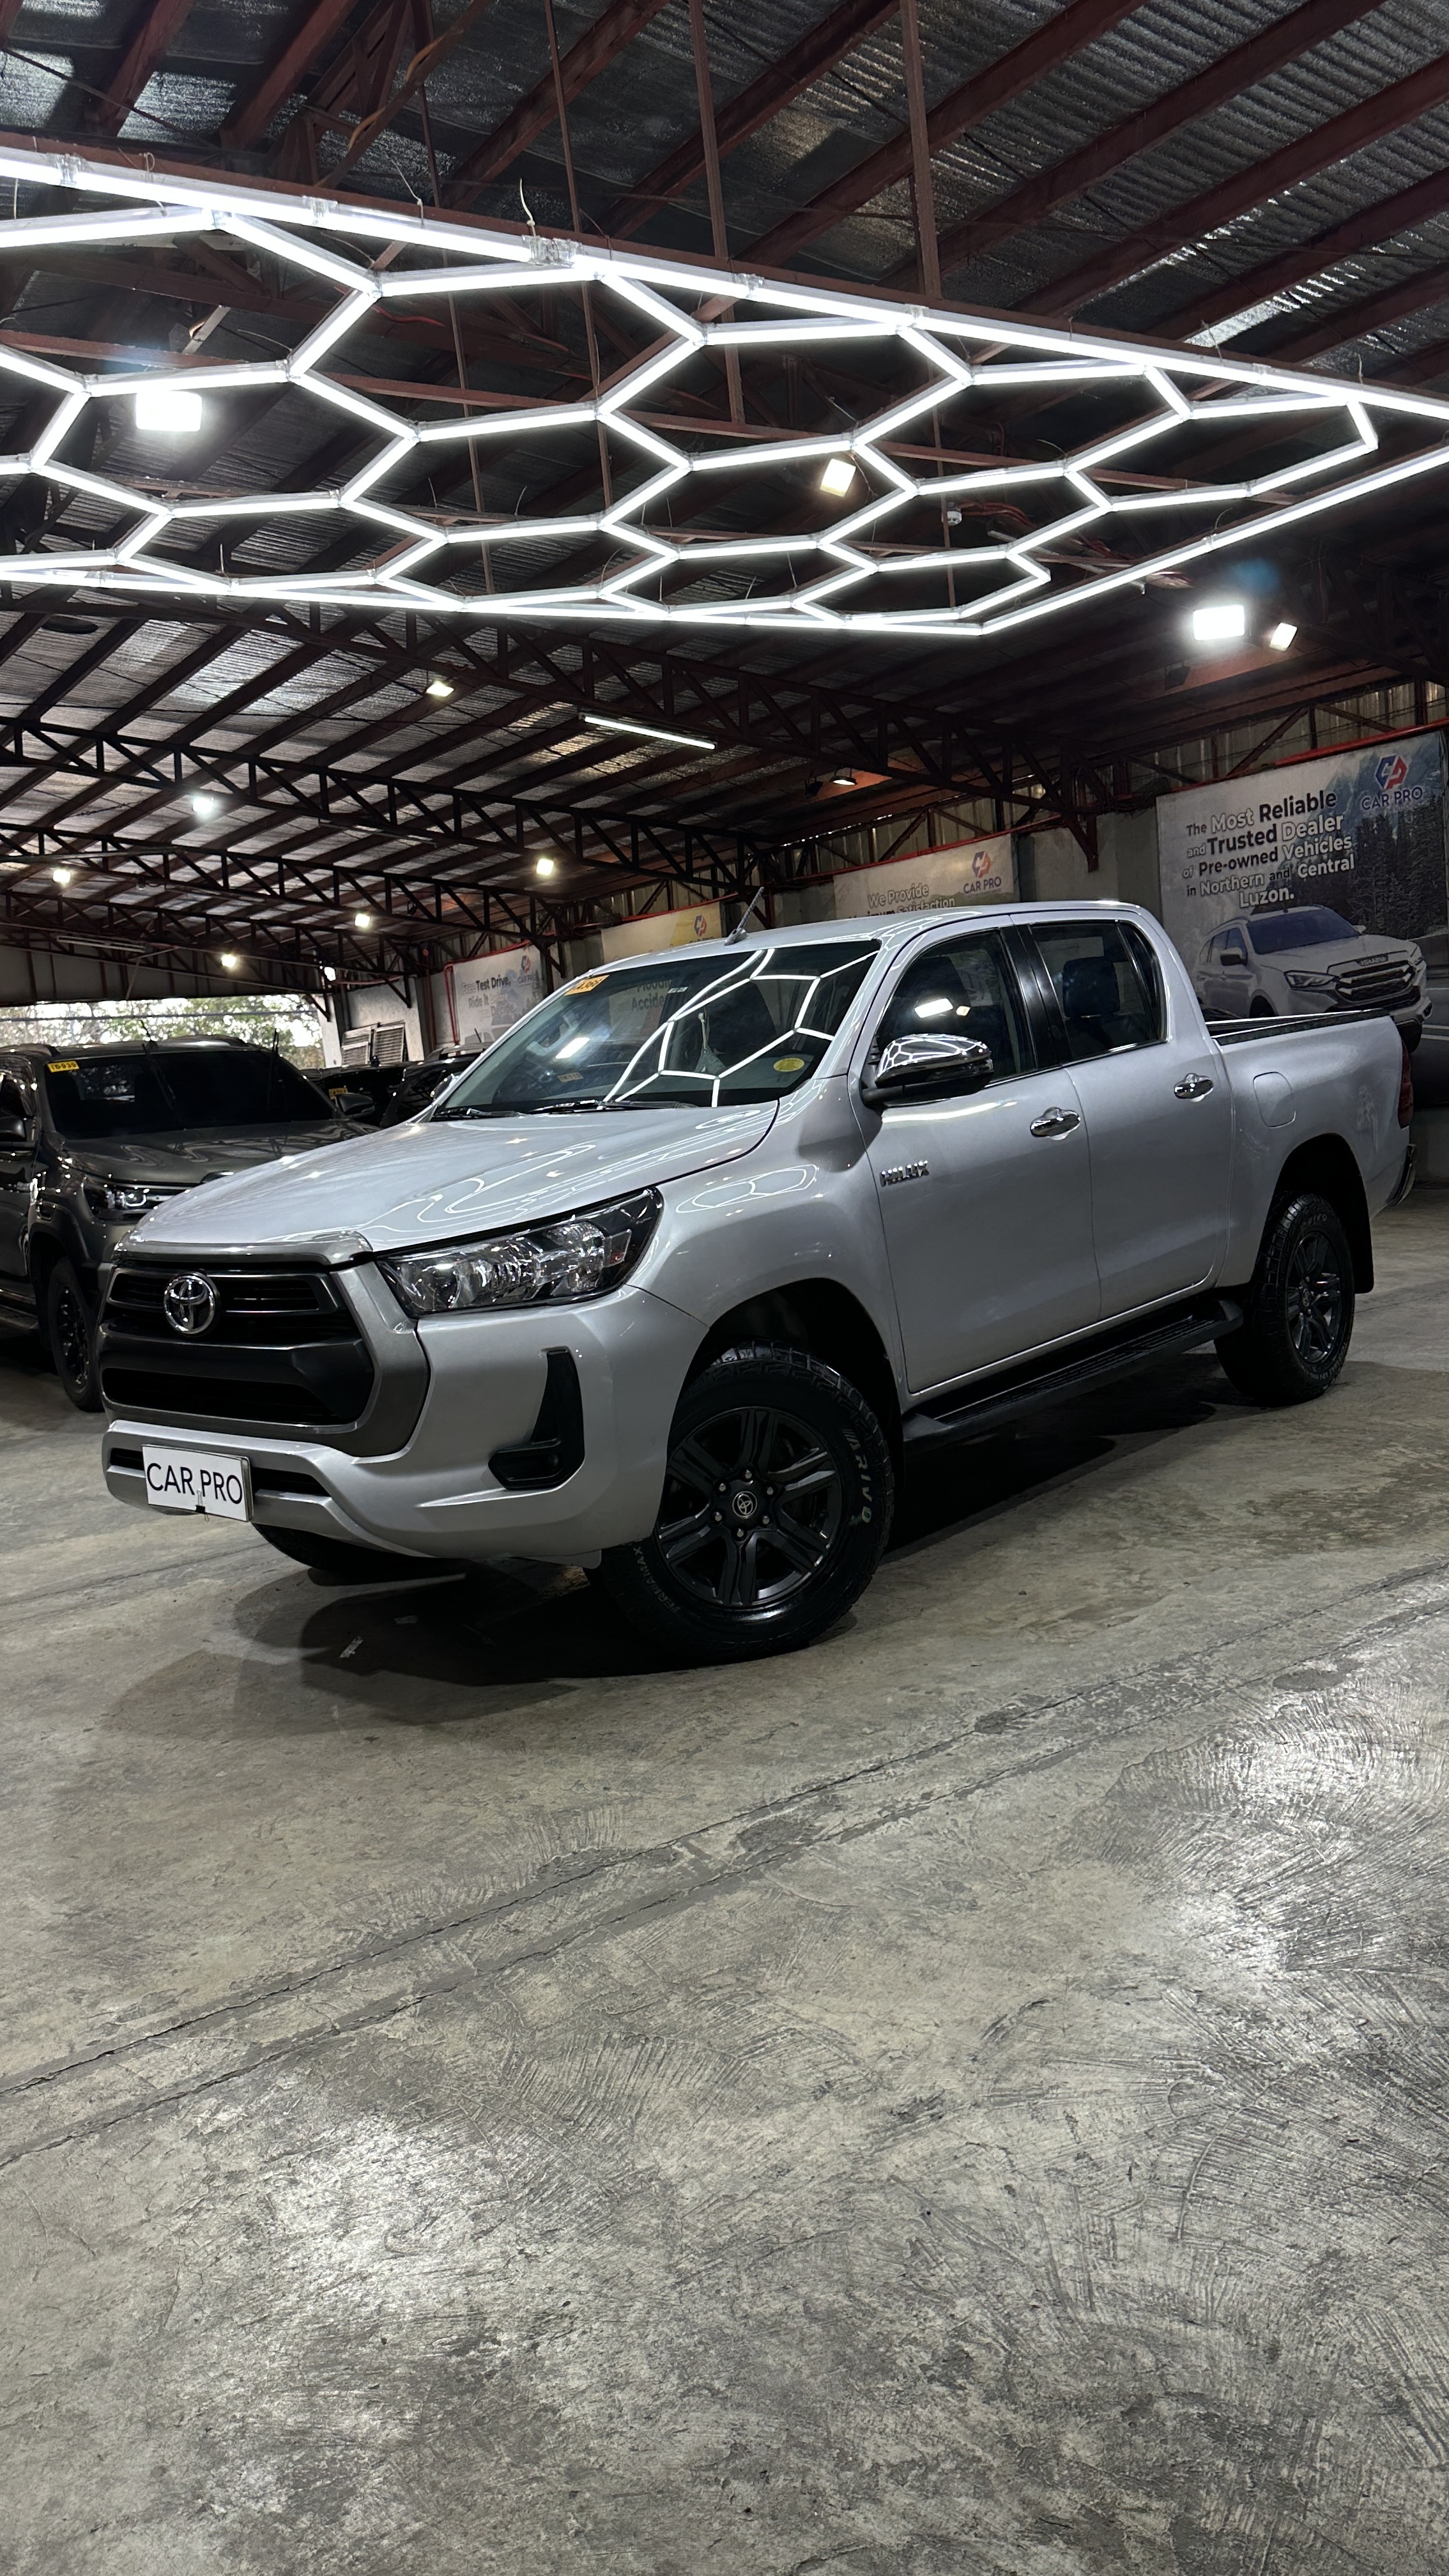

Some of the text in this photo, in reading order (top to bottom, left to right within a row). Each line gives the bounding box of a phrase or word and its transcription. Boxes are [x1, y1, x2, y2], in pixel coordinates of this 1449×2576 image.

[1361, 793, 1390, 810] CAR
[1394, 786, 1423, 804] PRO
[1186, 790, 1337, 836] The Most Reliable
[1186, 815, 1344, 858] and Trusted Dealer
[1183, 836, 1352, 878] of Pre-owned Vehicles
[963, 881, 981, 894] CAR
[983, 877, 1002, 890] PRO
[1186, 854, 1354, 896] in Northern and Central
[868, 883, 929, 908] We Provide
[1239, 887, 1294, 908] Luzon.
[476, 980, 490, 991] Test
[491, 974, 511, 988] Drive,
[468, 996, 483, 1008] Ride
[484, 994, 489, 1006] it
[880, 1160, 930, 1187] HILUX
[146, 1462, 243, 1505] CAR PRO
